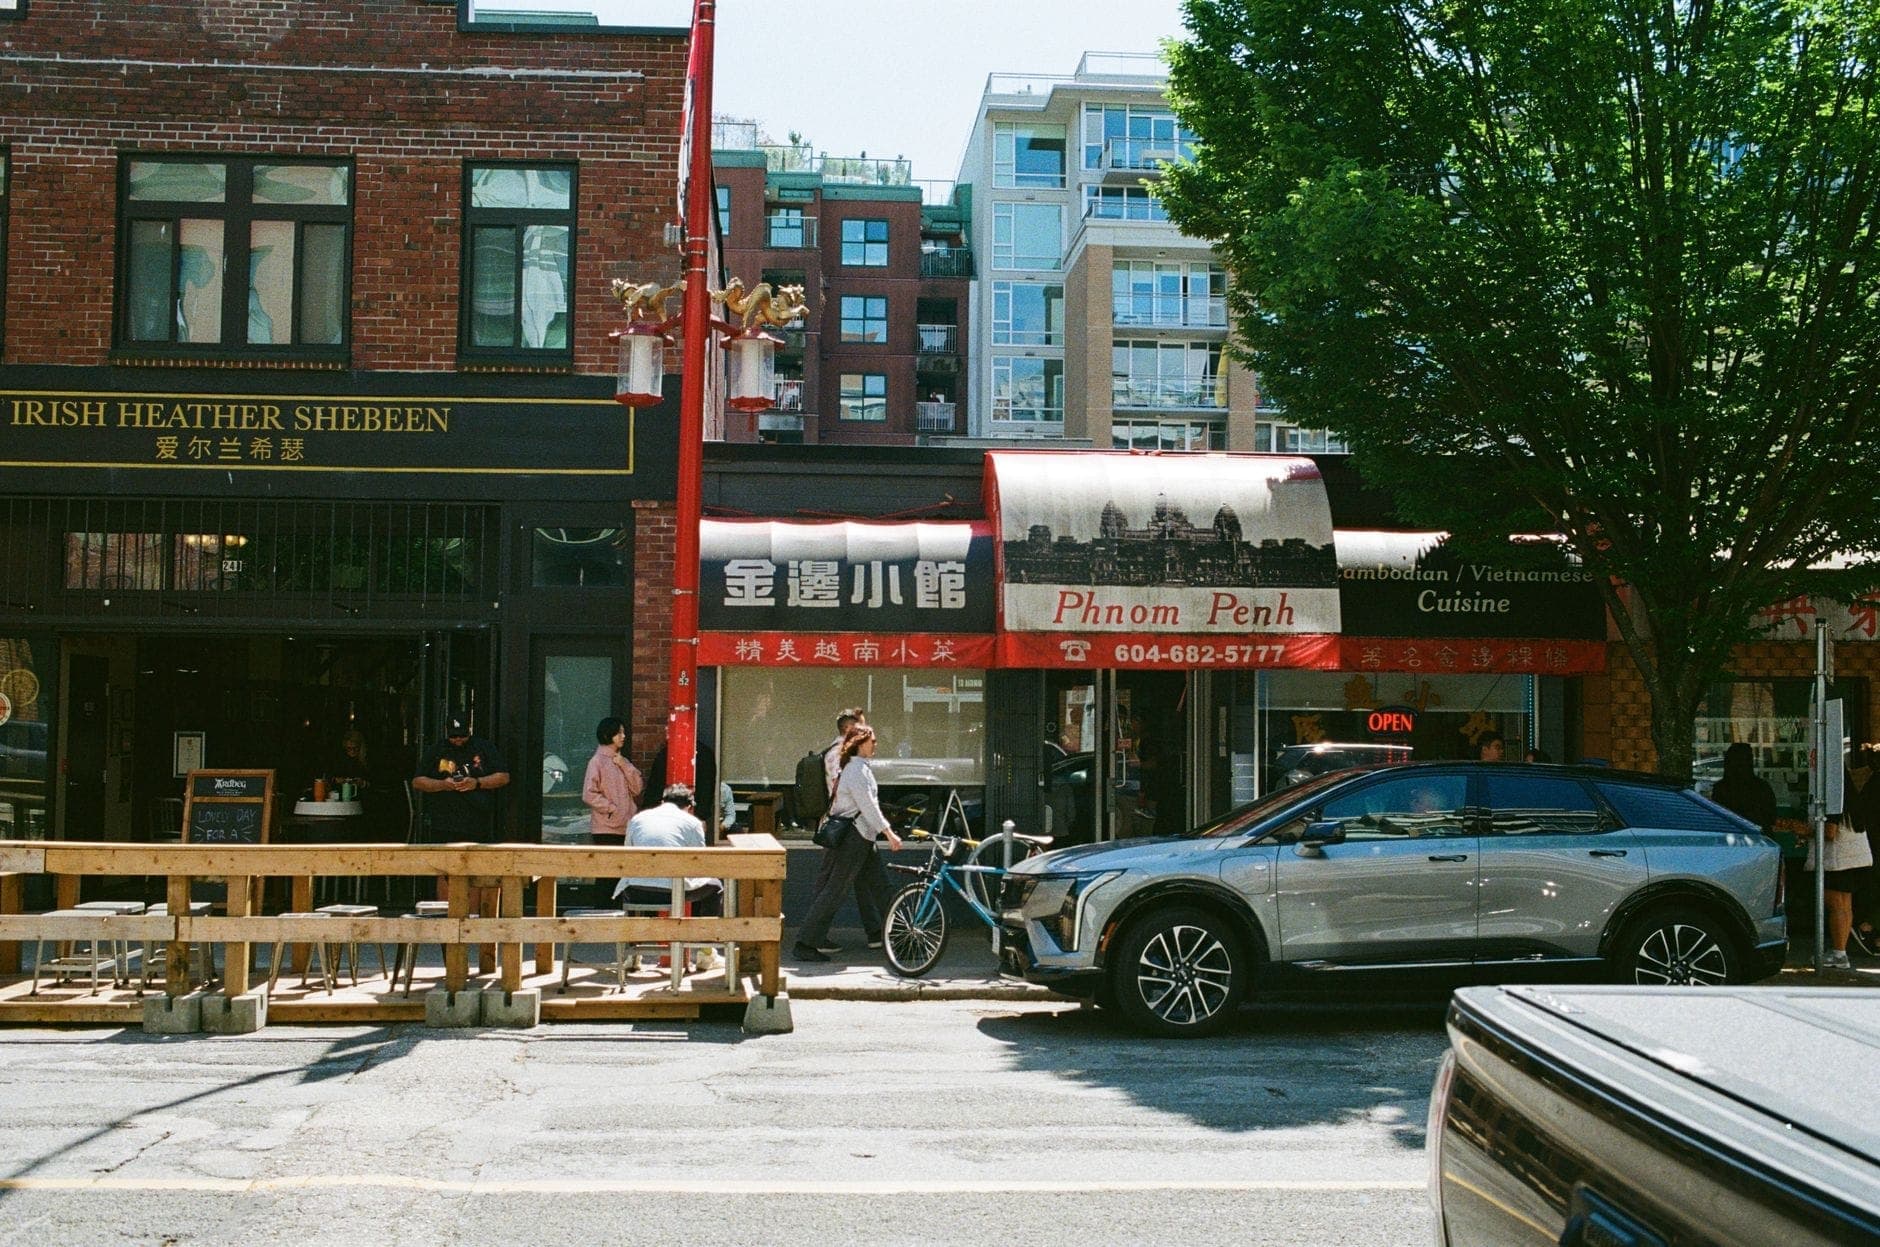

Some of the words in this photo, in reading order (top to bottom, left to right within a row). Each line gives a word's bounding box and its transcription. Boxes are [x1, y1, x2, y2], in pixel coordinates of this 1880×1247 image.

[10, 400, 108, 427] IRISH
[117, 402, 285, 429] HEATHER
[294, 405, 450, 432] SHEBEEN
[155, 435, 304, 461] 爱尔兰希瑟
[724, 559, 966, 609] 金邊小館
[1338, 563, 1449, 581] ambodian
[1470, 565, 1594, 582] Vietnamese
[1053, 591, 1180, 625] Phnom
[1207, 592, 1295, 626] Penh
[1417, 589, 1510, 612] Cuisine
[735, 639, 956, 663] 精美越南小菜
[1115, 644, 1285, 663] 604-682-5777
[1368, 713, 1413, 732] OPEN
[206, 829, 226, 841] FOR
